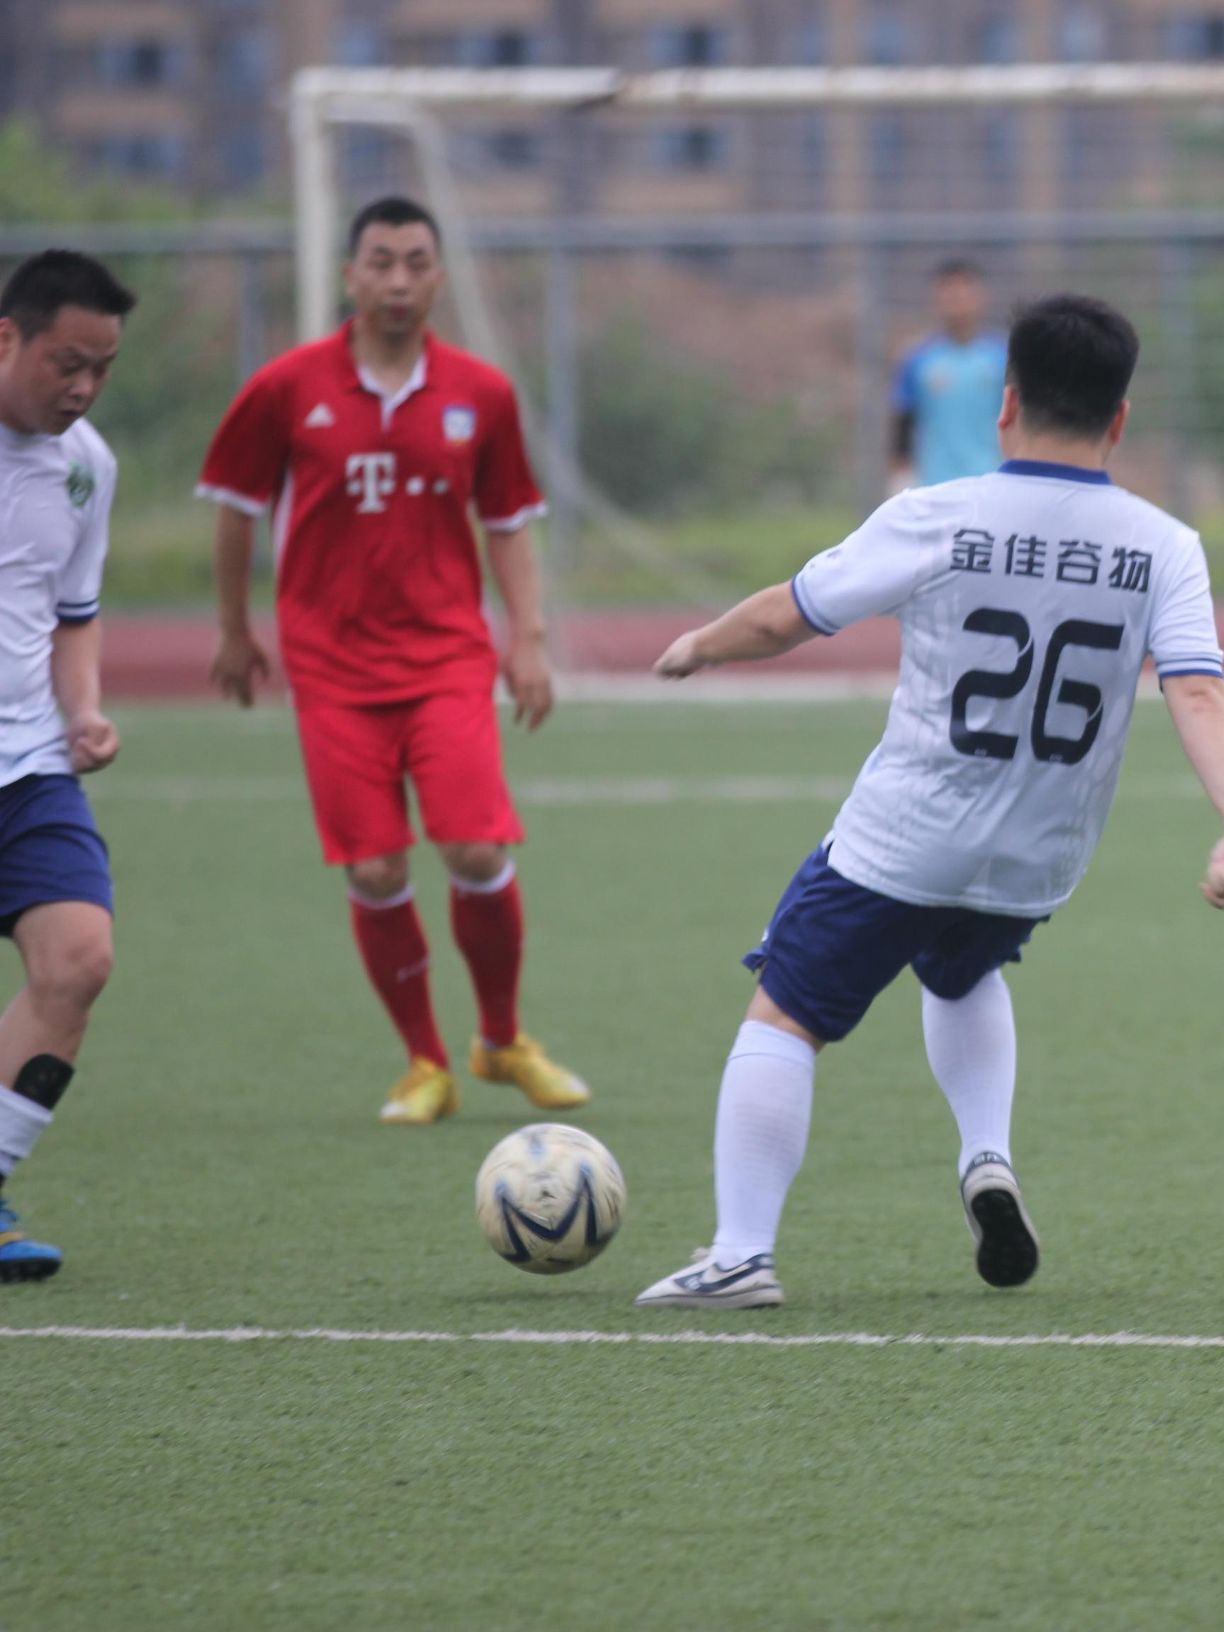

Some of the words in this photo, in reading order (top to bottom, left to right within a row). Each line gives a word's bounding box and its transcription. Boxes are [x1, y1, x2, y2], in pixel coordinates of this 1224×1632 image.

[950, 528, 1153, 593] 金佳谷物
[950, 608, 1125, 766] 26
